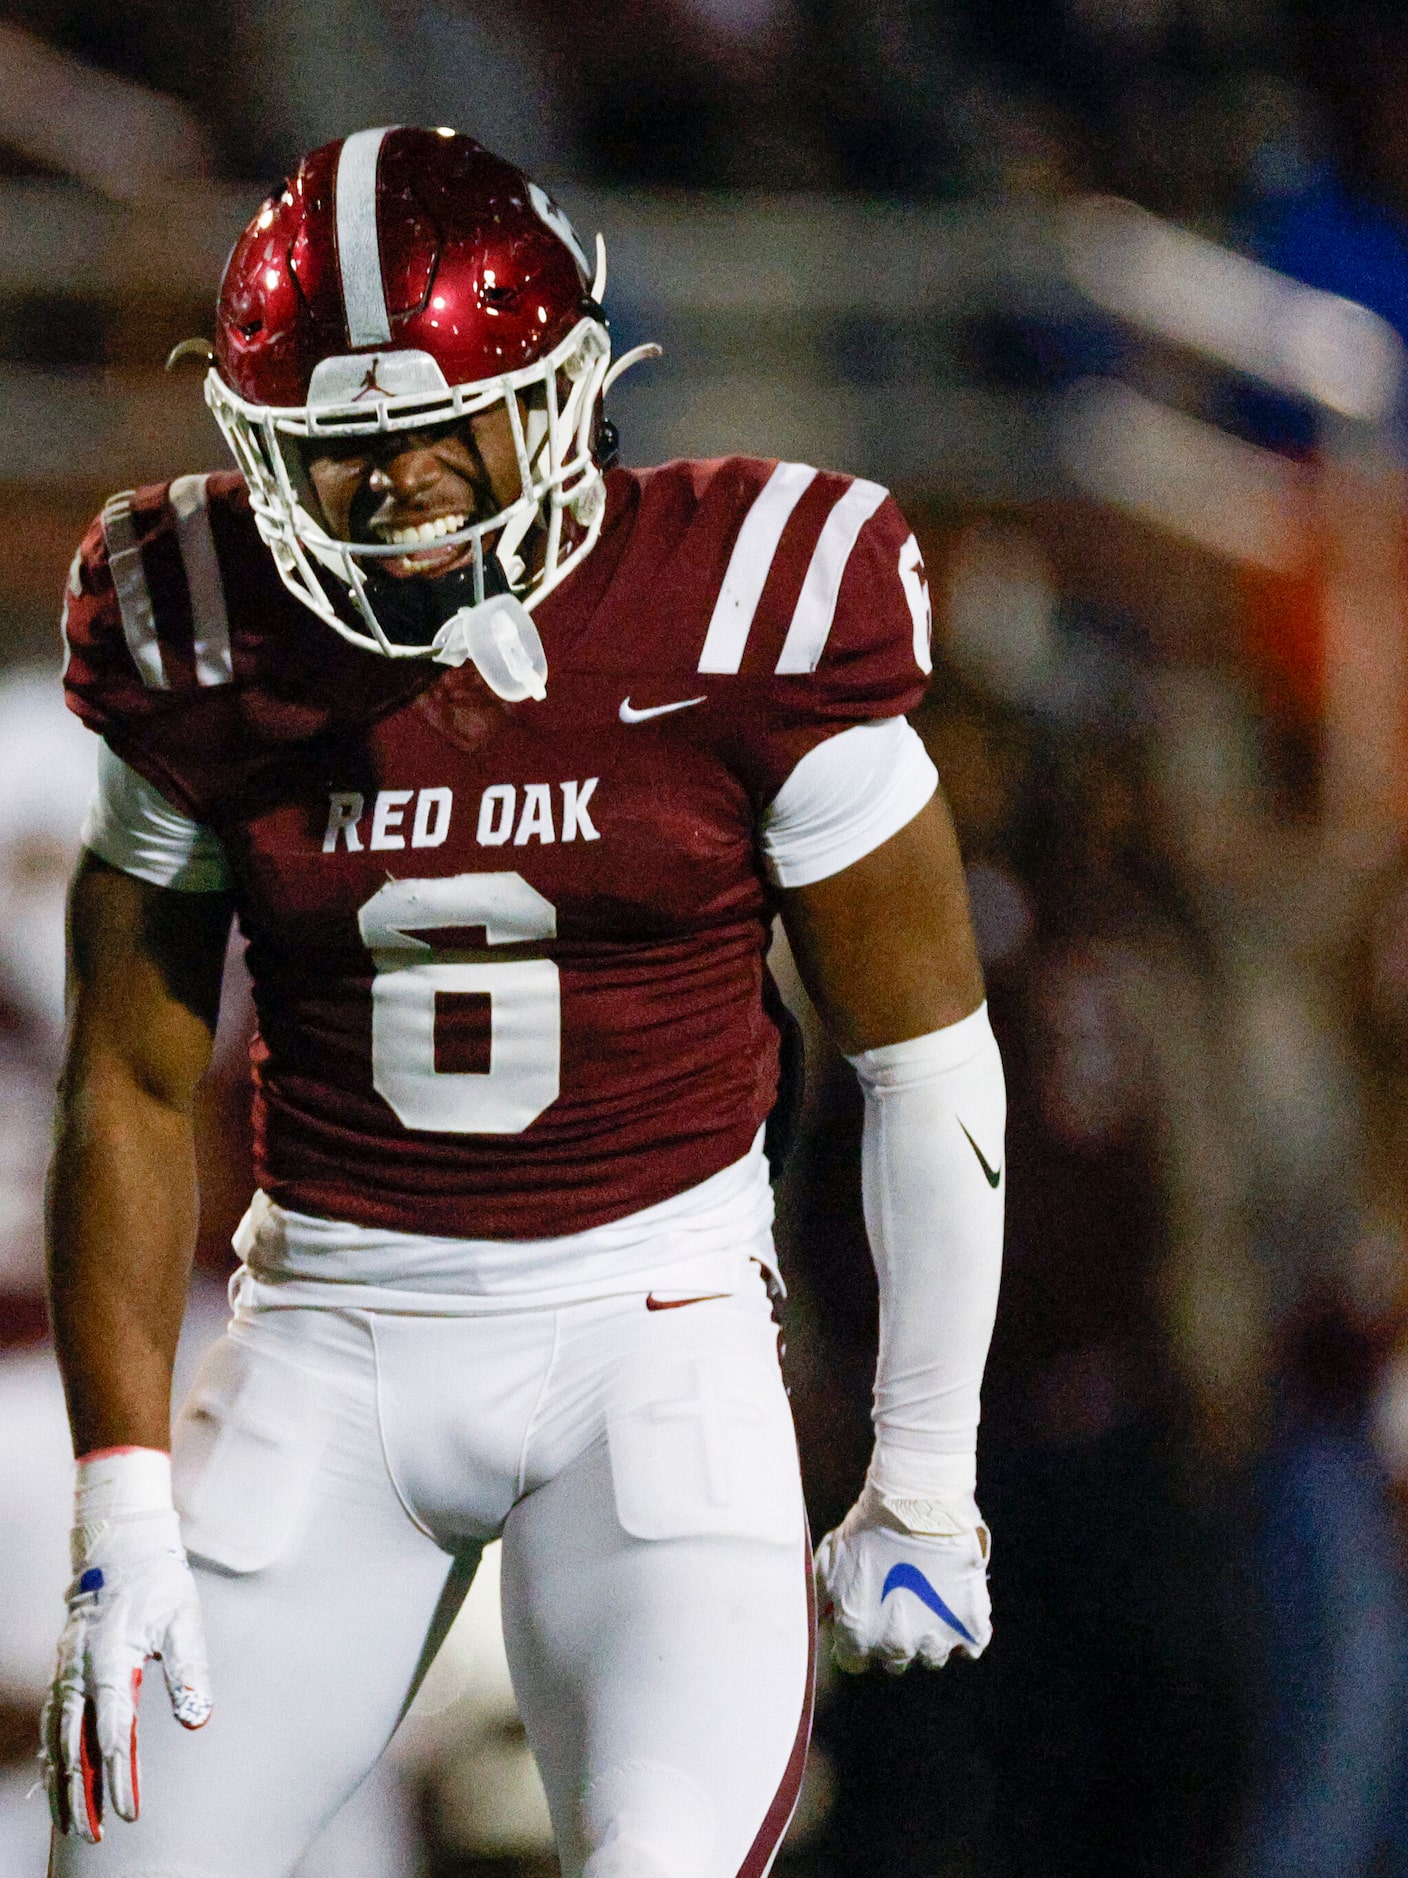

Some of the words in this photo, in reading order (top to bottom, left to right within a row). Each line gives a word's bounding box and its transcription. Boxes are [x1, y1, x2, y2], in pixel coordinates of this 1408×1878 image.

[322, 786, 453, 853] RED
[476, 777, 601, 847] OAK
[357, 870, 561, 1135] 6
